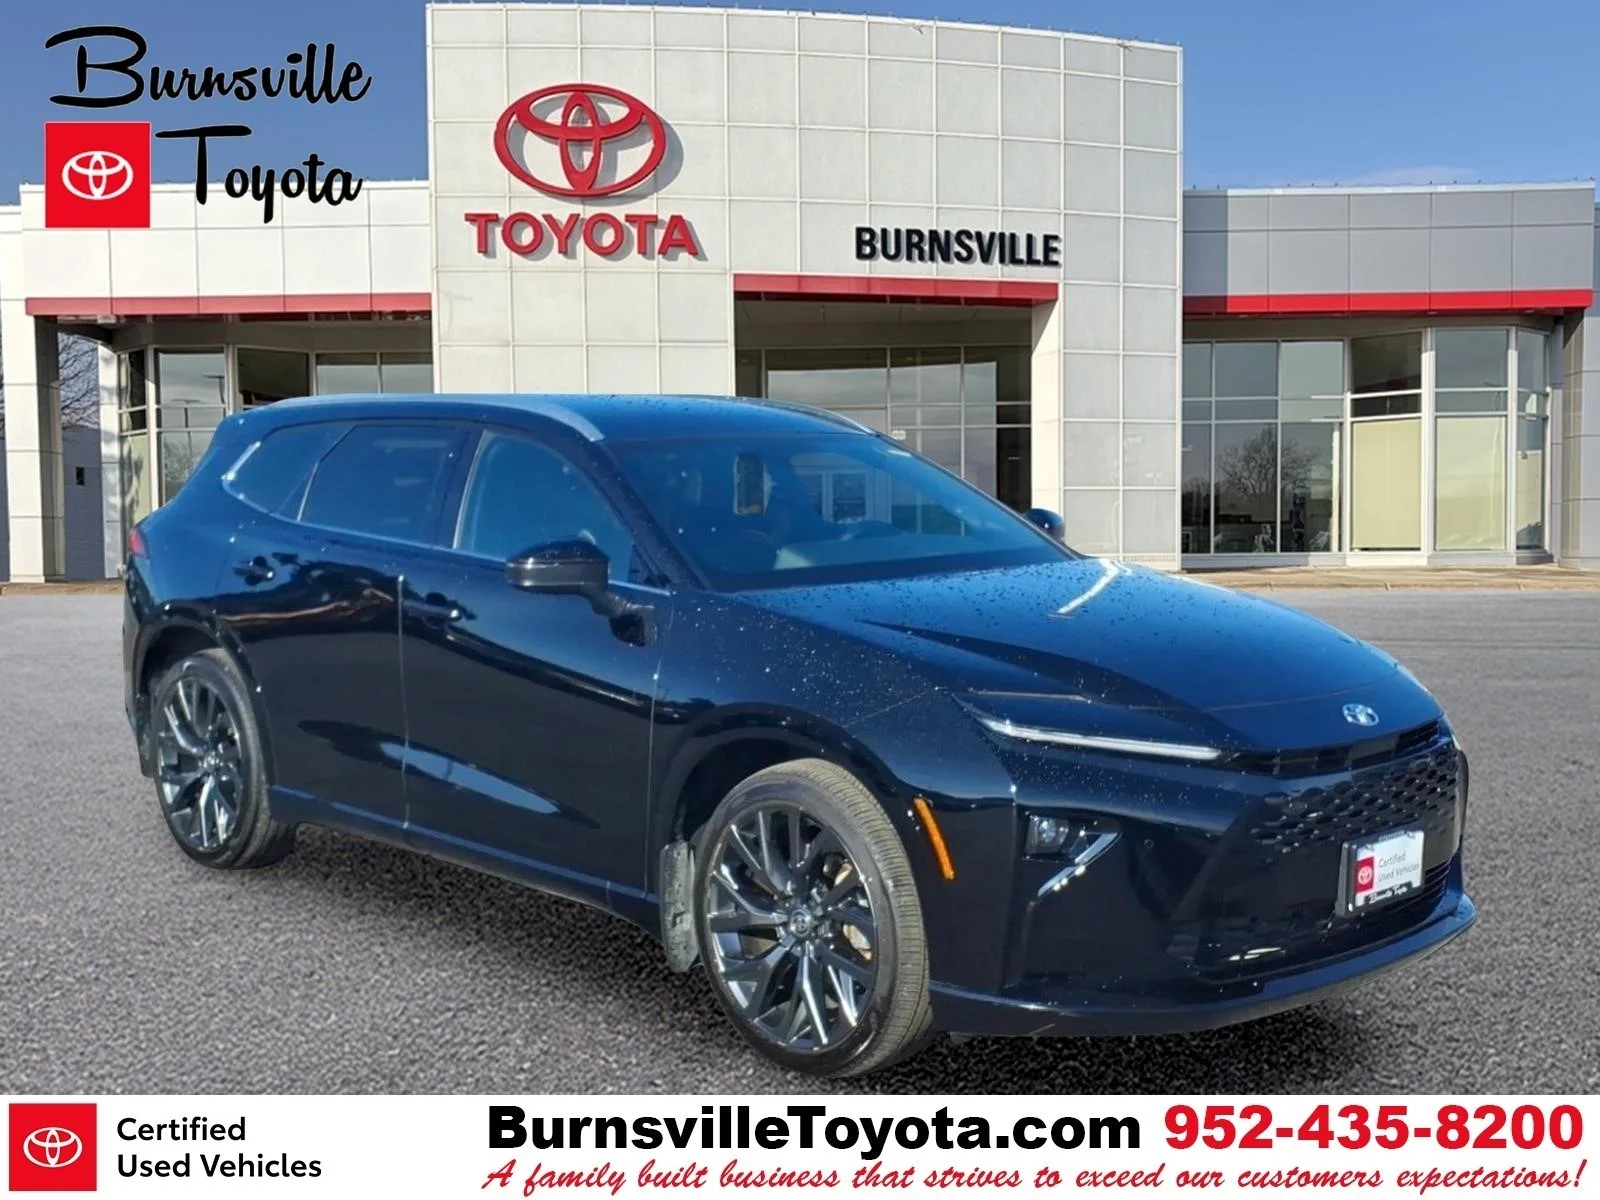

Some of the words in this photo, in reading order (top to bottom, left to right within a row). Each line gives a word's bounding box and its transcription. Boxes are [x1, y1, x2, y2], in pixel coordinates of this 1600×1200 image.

[465, 211, 700, 260] TOYOTA
[855, 226, 1061, 268] BURNSVILLE
[1379, 851, 1406, 867] Certified
